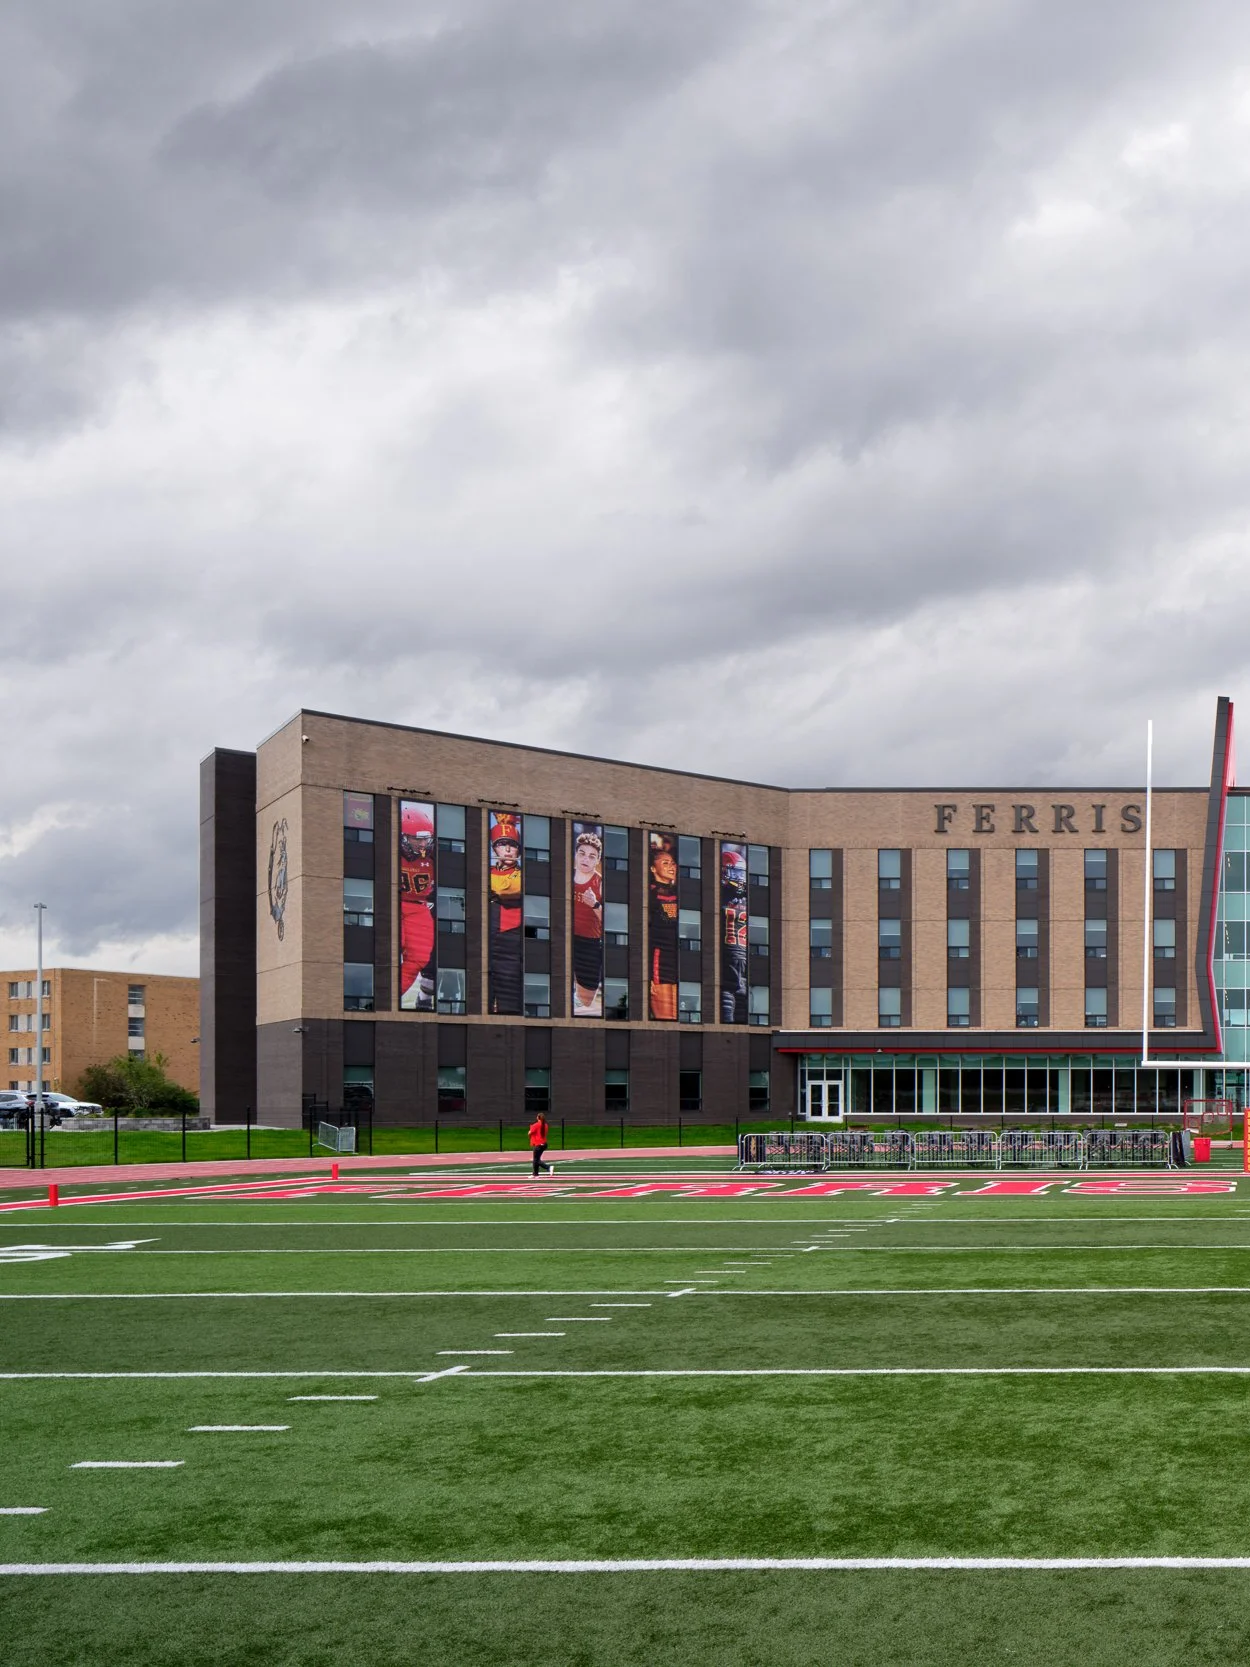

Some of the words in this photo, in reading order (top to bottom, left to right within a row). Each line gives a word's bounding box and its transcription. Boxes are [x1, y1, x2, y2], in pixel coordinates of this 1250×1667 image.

[935, 804, 1142, 833] FERRIS
[501, 824, 512, 837] F
[184, 1180, 1236, 1199] FERRIS
